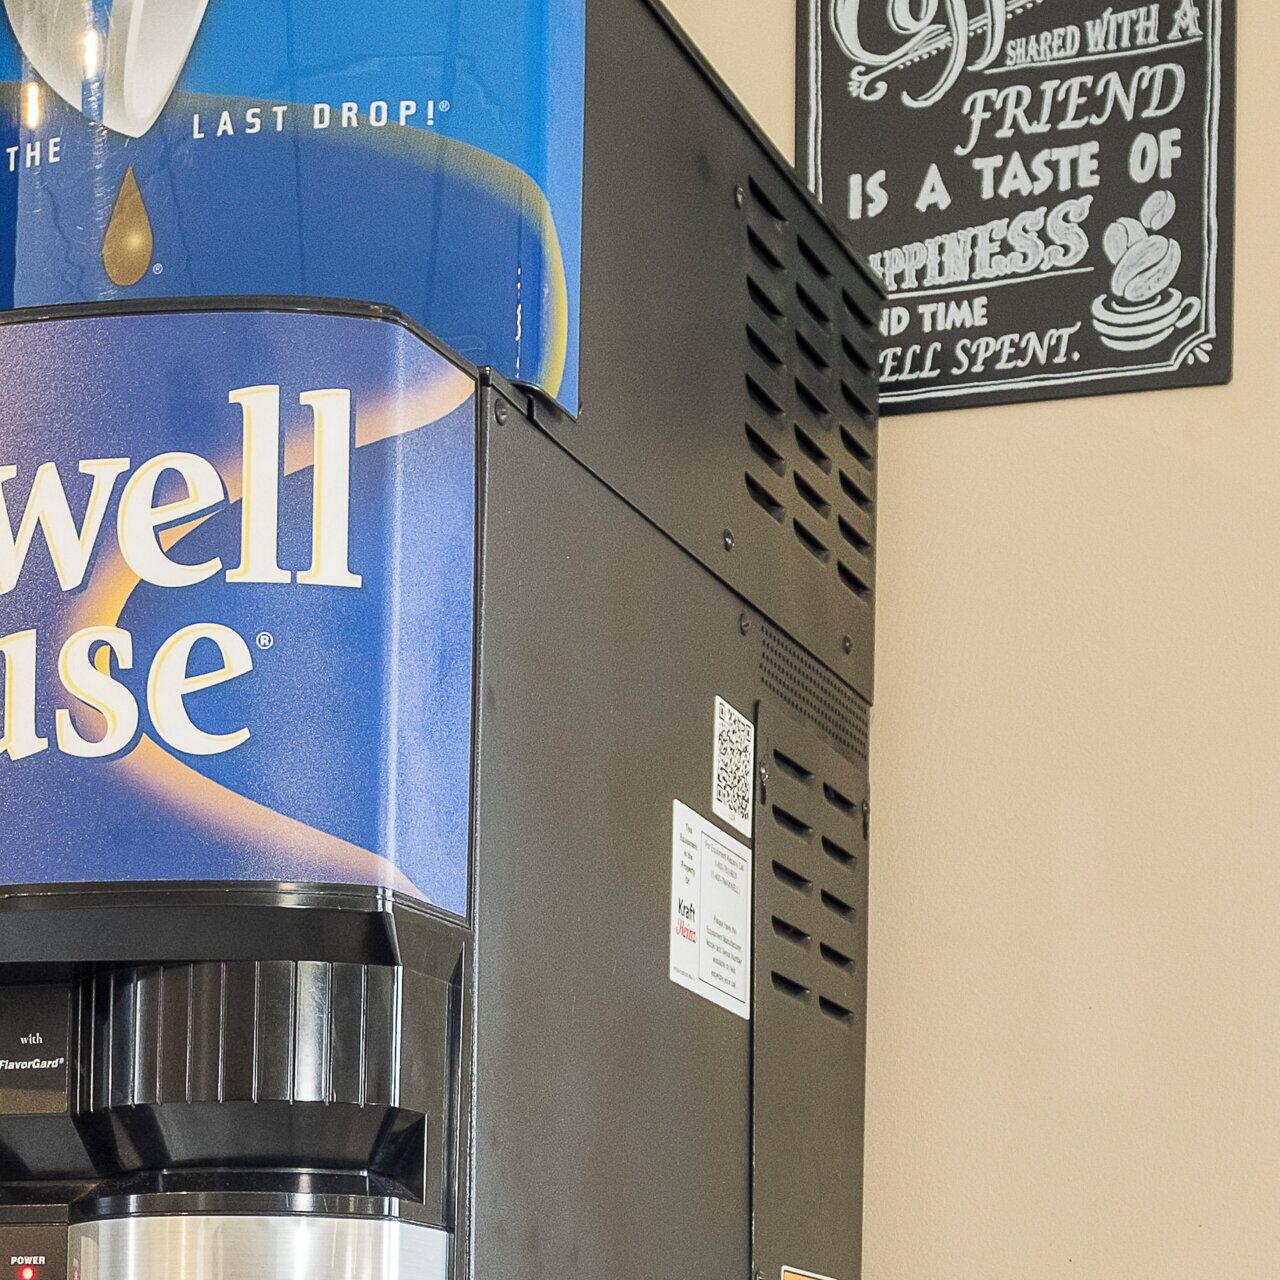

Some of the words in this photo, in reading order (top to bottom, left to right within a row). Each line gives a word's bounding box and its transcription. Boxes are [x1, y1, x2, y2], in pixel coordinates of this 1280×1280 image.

[1006, 31, 1080, 66] SHARED
[1085, 3, 1159, 54] WITH
[1170, 0, 1203, 40] A
[192, 105, 288, 139] LAST
[953, 62, 1186, 156] FRIEND
[6, 137, 61, 172] THE
[848, 170, 888, 219] IS
[915, 164, 952, 212] A
[972, 141, 1100, 200] TASTE
[1128, 128, 1182, 183] OF
[918, 296, 988, 333] TIME
[951, 322, 1082, 374] SPENT.
[678, 897, 696, 923] Kraft
[20, 1032, 43, 1045] with
[11, 1256, 46, 1265] POWER
